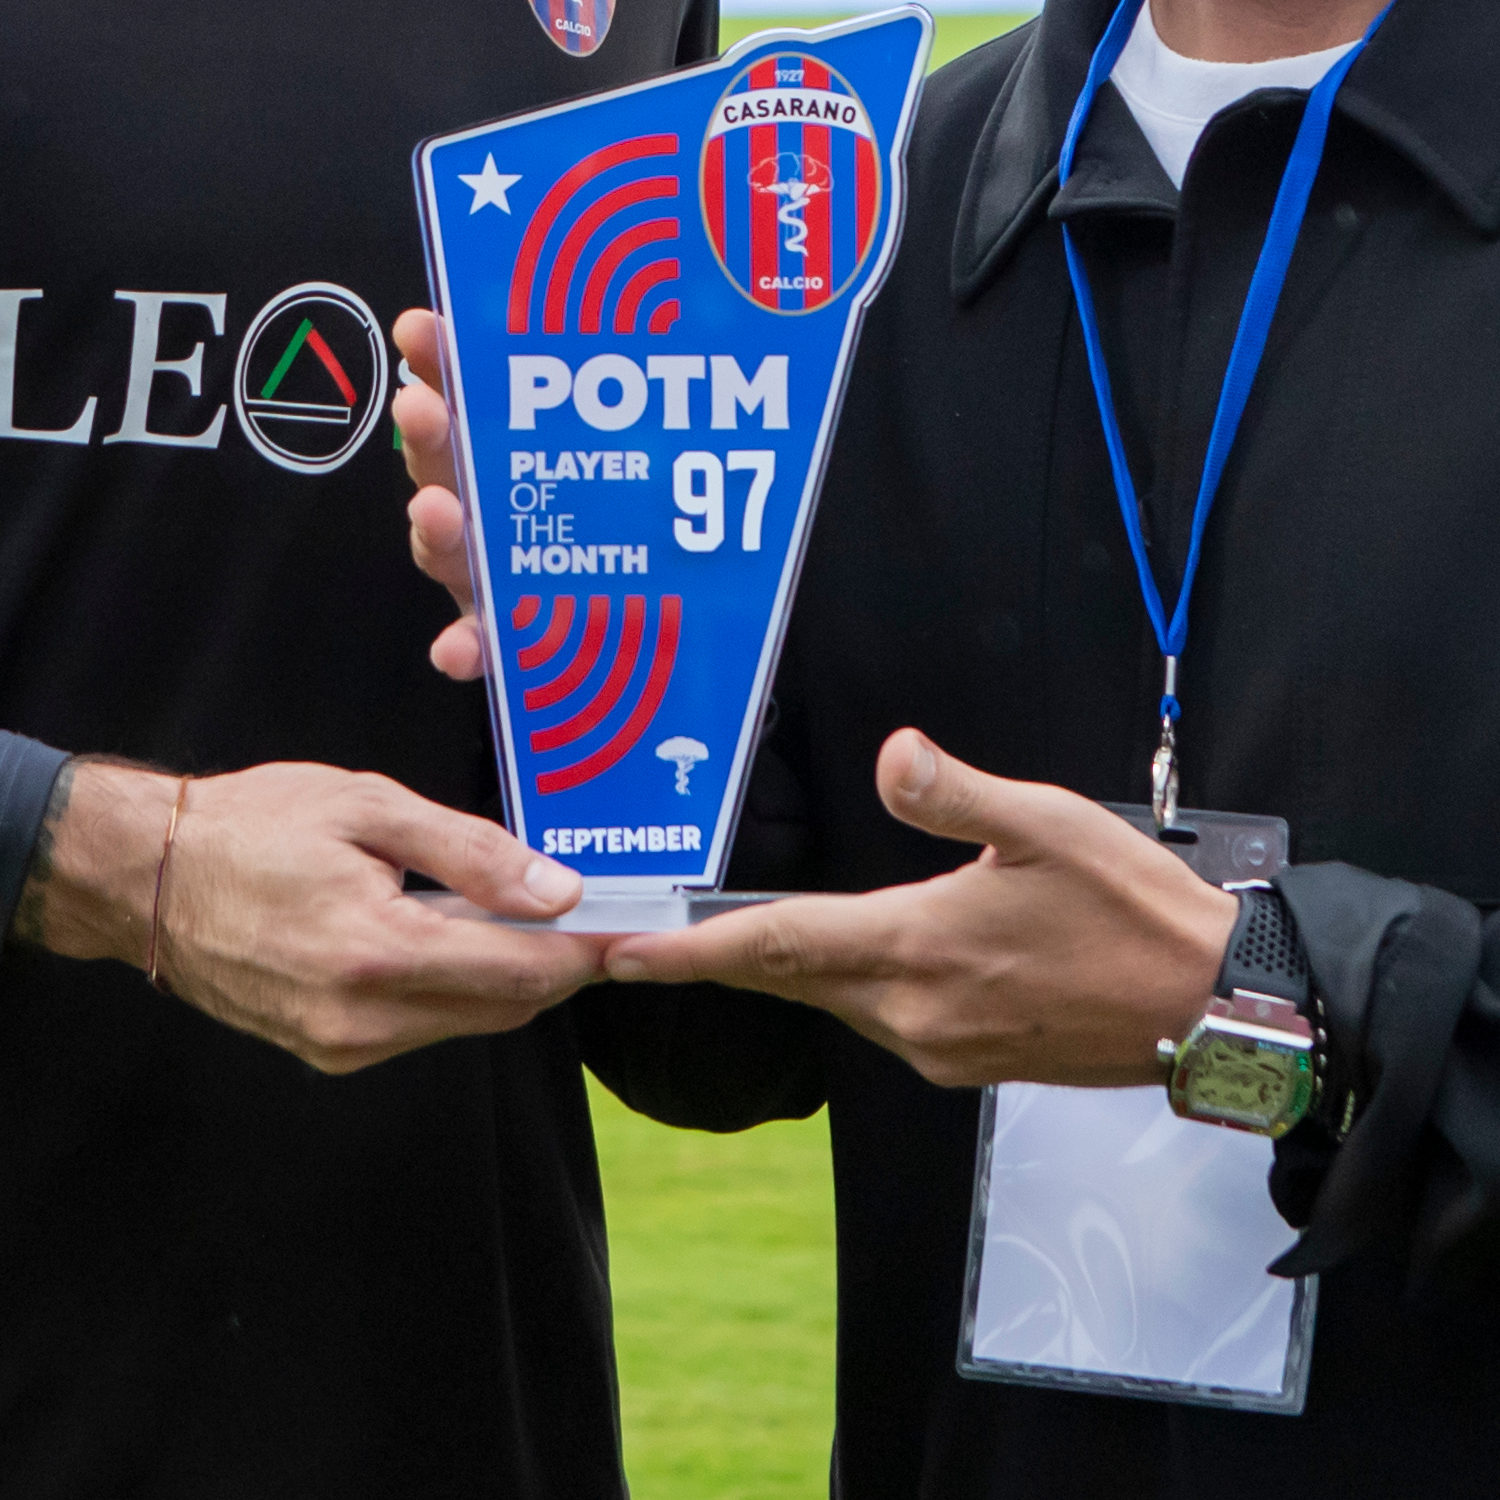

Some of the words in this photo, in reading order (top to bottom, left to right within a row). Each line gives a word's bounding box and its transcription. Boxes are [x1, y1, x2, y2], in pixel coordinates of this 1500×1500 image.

[555, 18, 592, 37] CALCIO
[774, 69, 805, 83] 1927
[723, 97, 857, 125] CASARANO
[758, 276, 824, 290] CALCIO
[507, 353, 791, 432] POTM
[509, 451, 650, 481] PLAYER
[509, 483, 557, 512] OF
[672, 449, 777, 553] 97
[509, 513, 576, 543] THE
[510, 545, 649, 575] MONTH
[542, 825, 702, 855] SEPTEMBER
